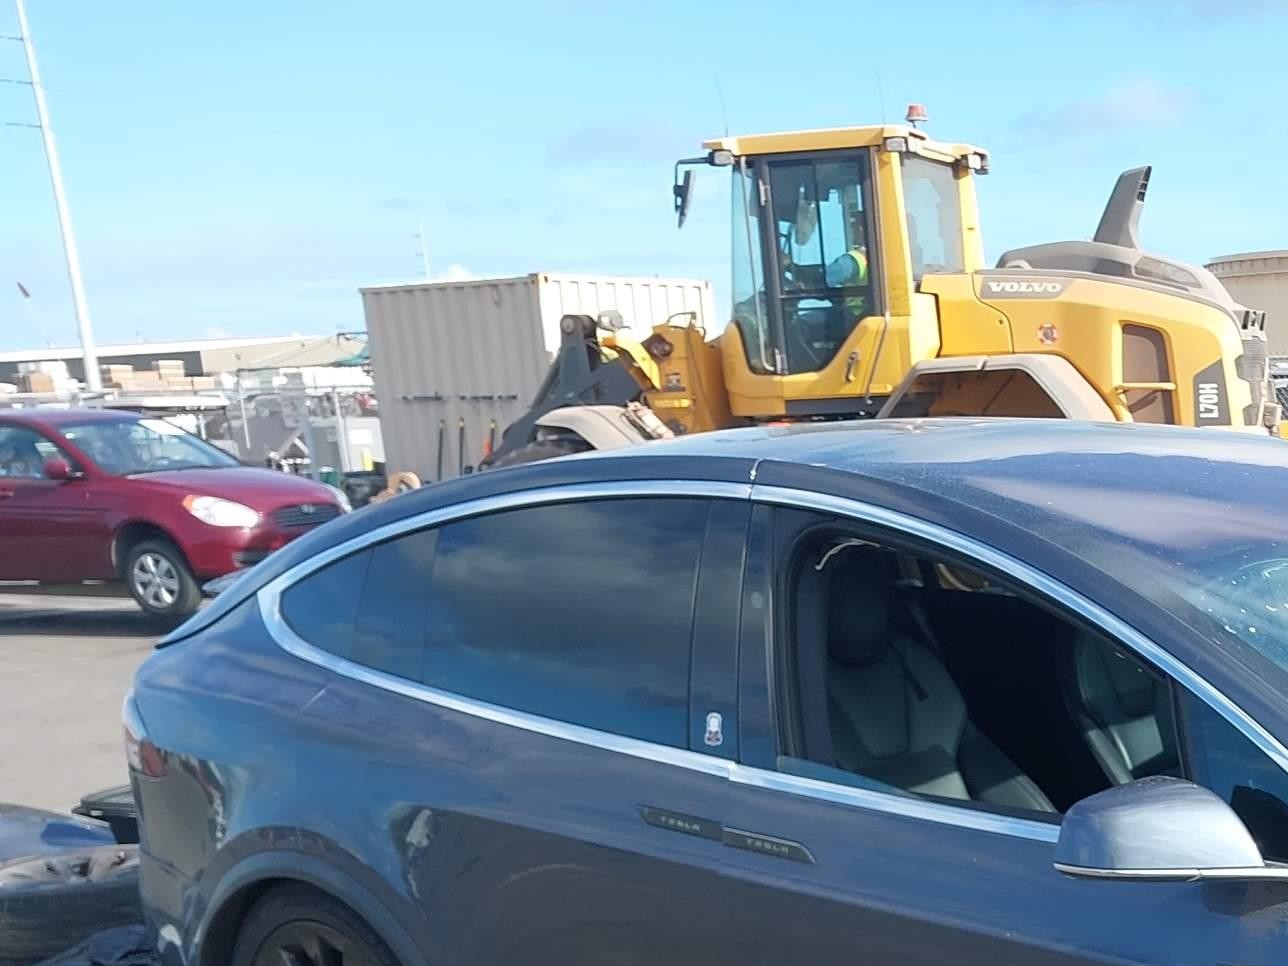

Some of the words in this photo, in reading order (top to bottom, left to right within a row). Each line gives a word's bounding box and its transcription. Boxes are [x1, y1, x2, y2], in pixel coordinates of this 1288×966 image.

[987, 281, 1062, 293] VOLVO
[1198, 383, 1219, 418] L70H
[660, 815, 701, 831] TESLA
[746, 837, 790, 855] TESLA
